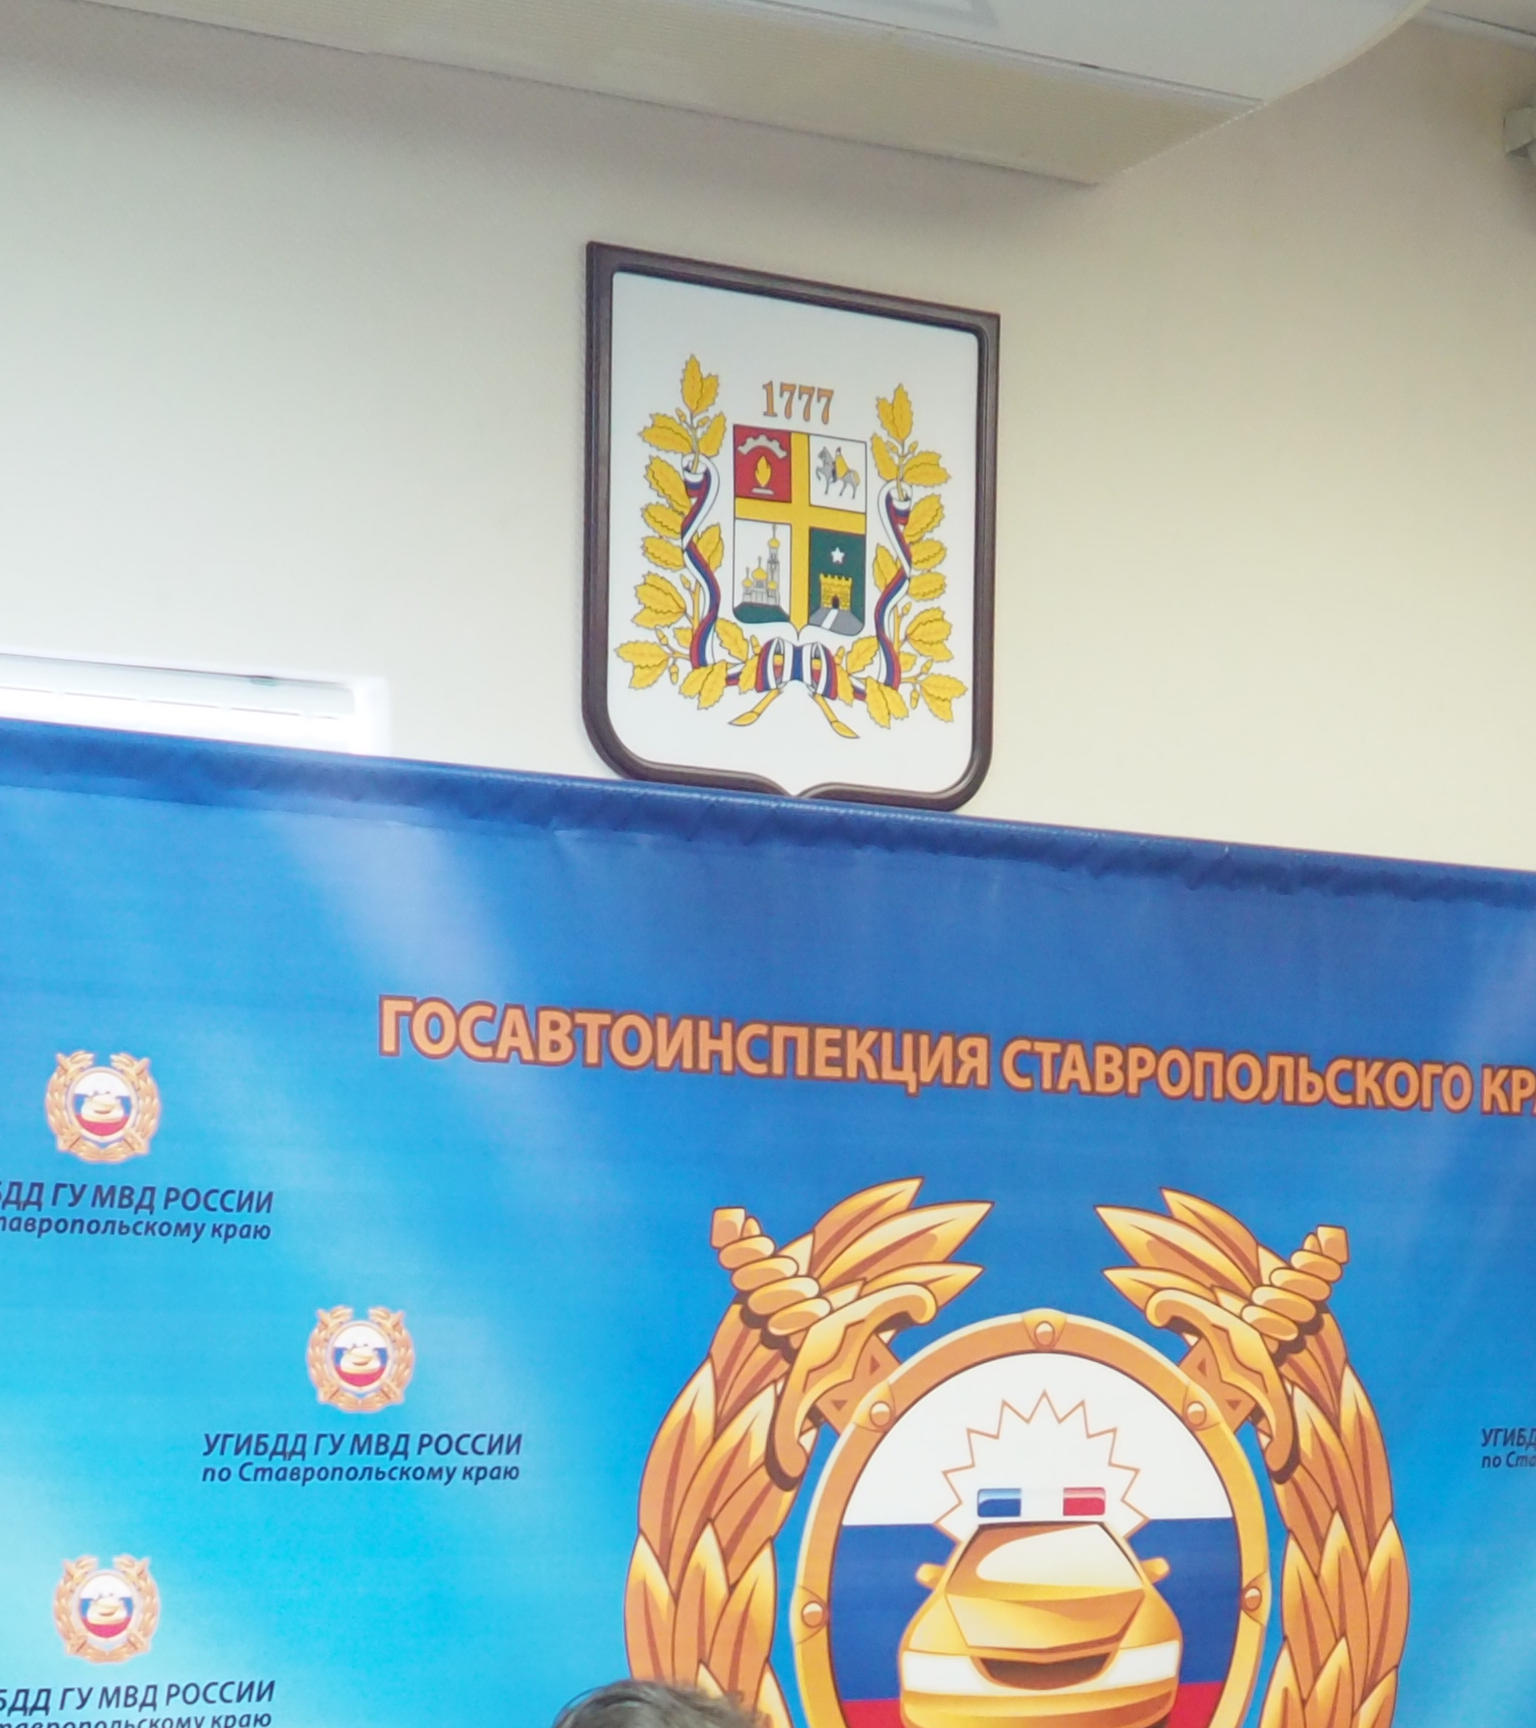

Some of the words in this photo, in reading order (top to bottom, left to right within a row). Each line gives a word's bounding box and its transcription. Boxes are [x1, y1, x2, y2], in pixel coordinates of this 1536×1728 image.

[762, 381, 835, 425] 1777
[379, 993, 991, 1097] ГОСАВТОИНСПЕКЦИЯ
[1001, 1034, 1472, 1115] СТАВРОПОЛЬСКОГО
[51, 1182, 86, 1209] ГУ
[91, 1183, 156, 1215] МВД
[163, 1186, 274, 1214] РОССИИ
[210, 1218, 272, 1244] краю
[202, 1432, 307, 1462] УГИБДД
[313, 1432, 345, 1457] ГУ
[350, 1432, 411, 1460] МВД
[417, 1433, 523, 1457] РОССИИ
[1482, 1455, 1502, 1468] по
[201, 1466, 232, 1483] по
[237, 1461, 457, 1487] Ставропольскому
[462, 1463, 520, 1487] краю
[59, 1687, 93, 1713] ГУ
[98, 1685, 159, 1713] МВД
[164, 1680, 276, 1708] РОССИИ
